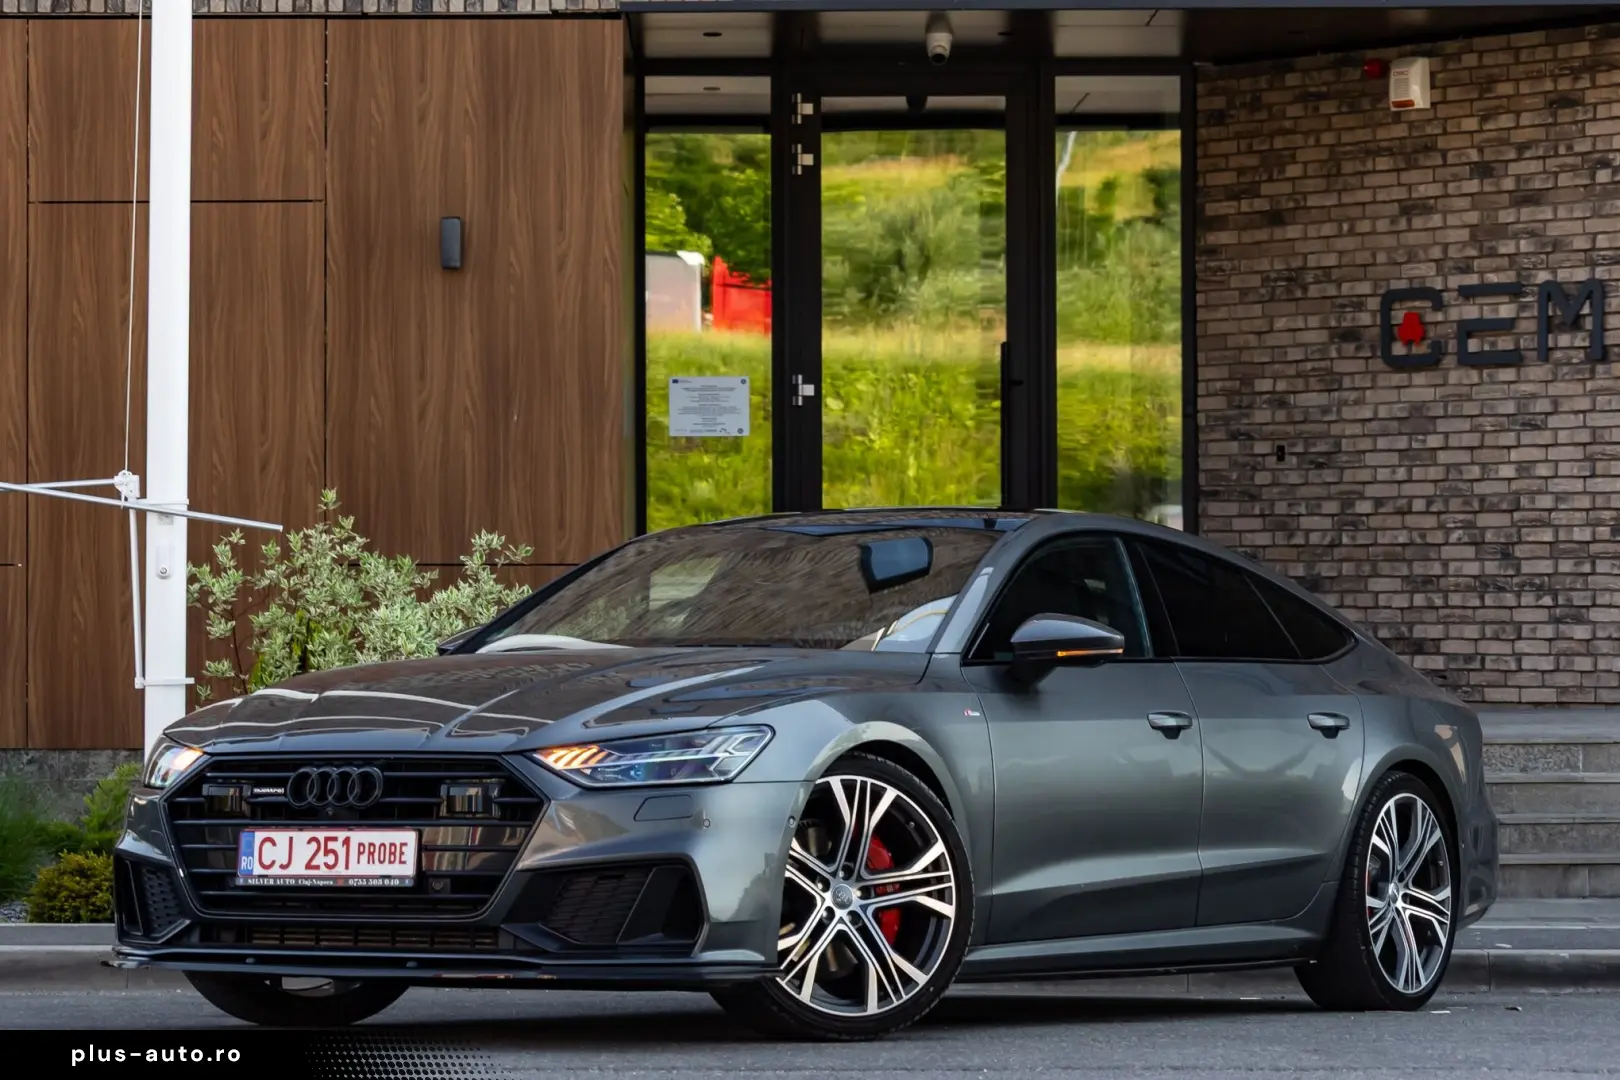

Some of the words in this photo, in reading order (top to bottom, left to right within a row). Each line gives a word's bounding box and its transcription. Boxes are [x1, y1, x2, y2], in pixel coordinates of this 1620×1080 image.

[1380, 279, 1604, 368] CEM
[241, 856, 253, 870] RO
[258, 836, 294, 870] CJ
[305, 836, 351, 870] 251
[357, 842, 408, 865] PROBE
